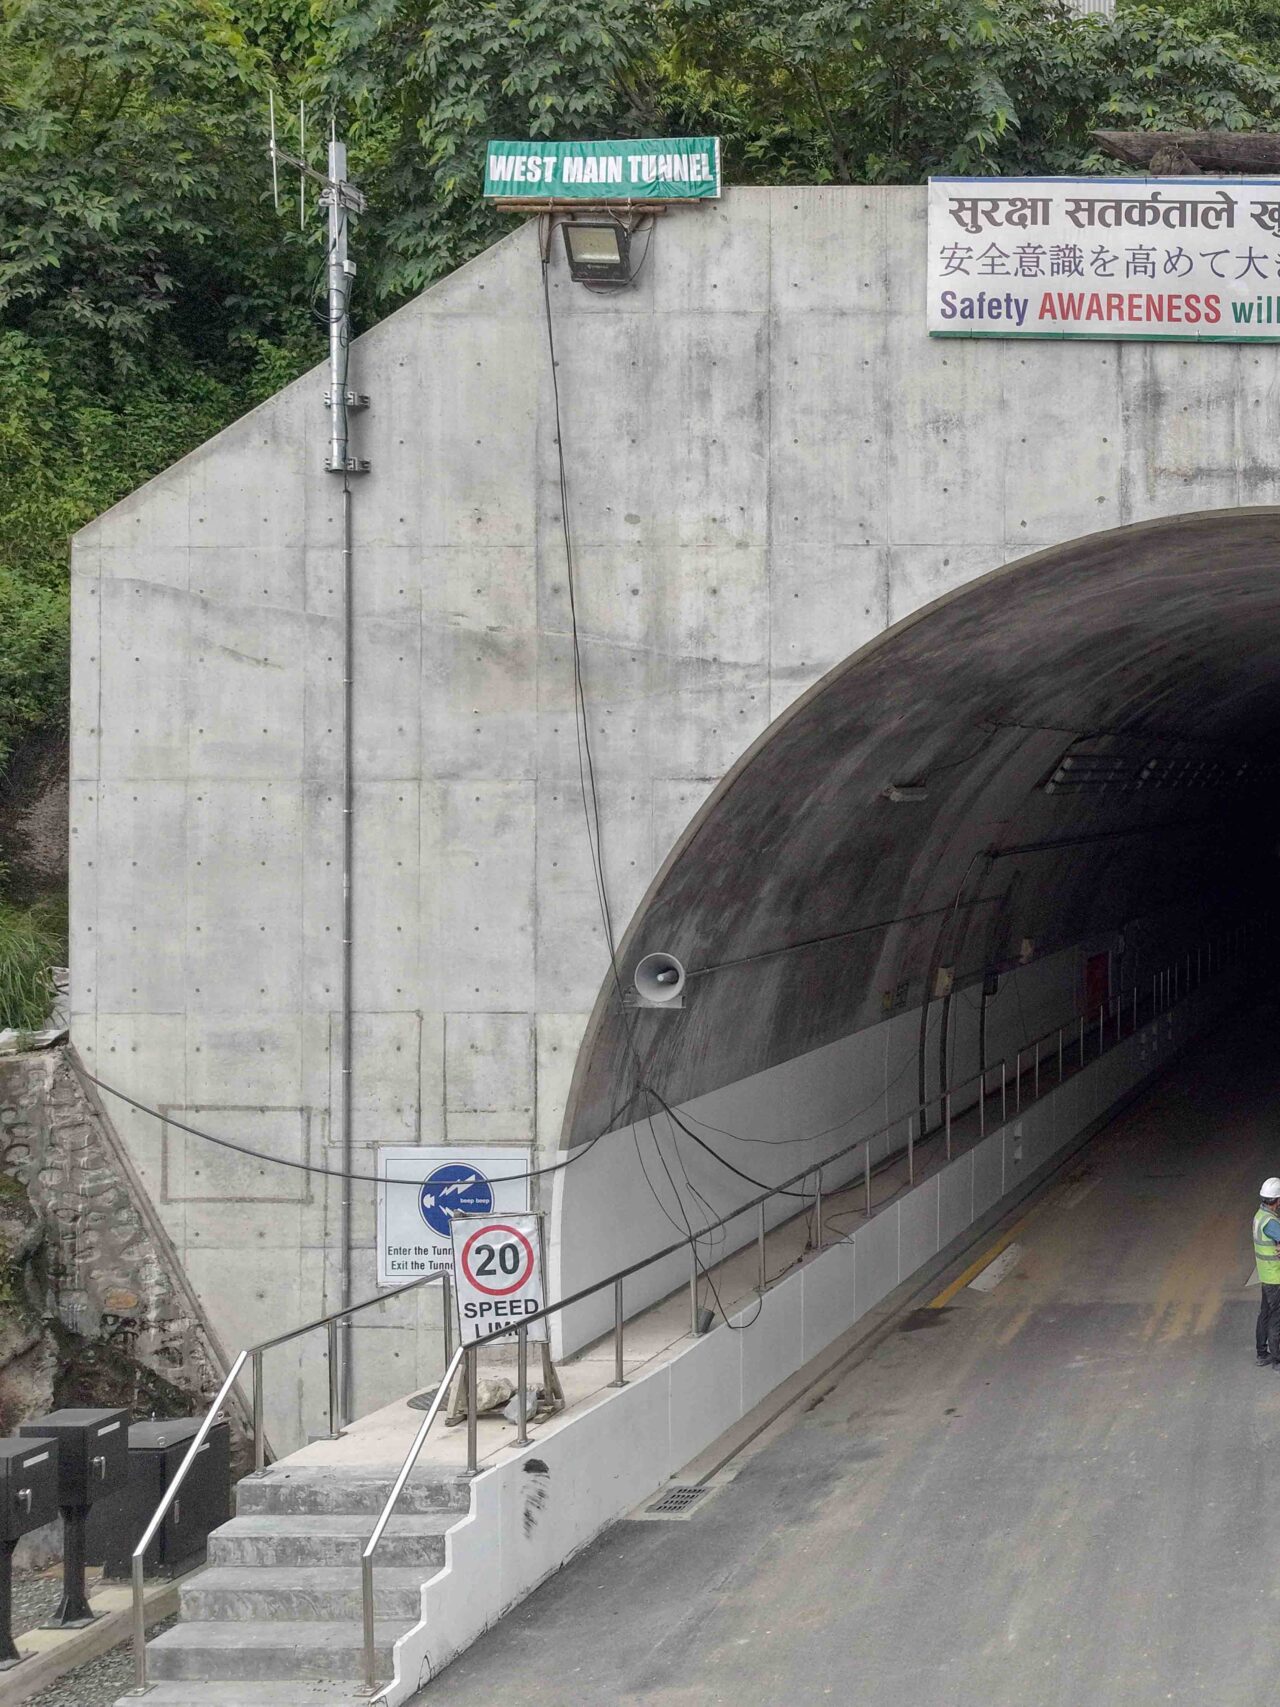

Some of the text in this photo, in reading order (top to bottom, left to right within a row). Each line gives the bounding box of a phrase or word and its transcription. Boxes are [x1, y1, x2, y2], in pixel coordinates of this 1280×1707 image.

[489, 153, 714, 184] WEST MAIN TUNNEL
[948, 197, 1053, 234] सुरक्षा
[1064, 191, 1238, 230] सतर्कताले
[940, 290, 1029, 326] Safety
[1038, 292, 1222, 324] AWARENESS
[387, 1245, 412, 1256] Enter
[414, 1245, 429, 1256] the
[474, 1243, 520, 1276] 20
[391, 1260, 408, 1270] Exit
[411, 1260, 425, 1270] the
[464, 1298, 539, 1319] SPEED
[474, 1321, 529, 1339] LIM
